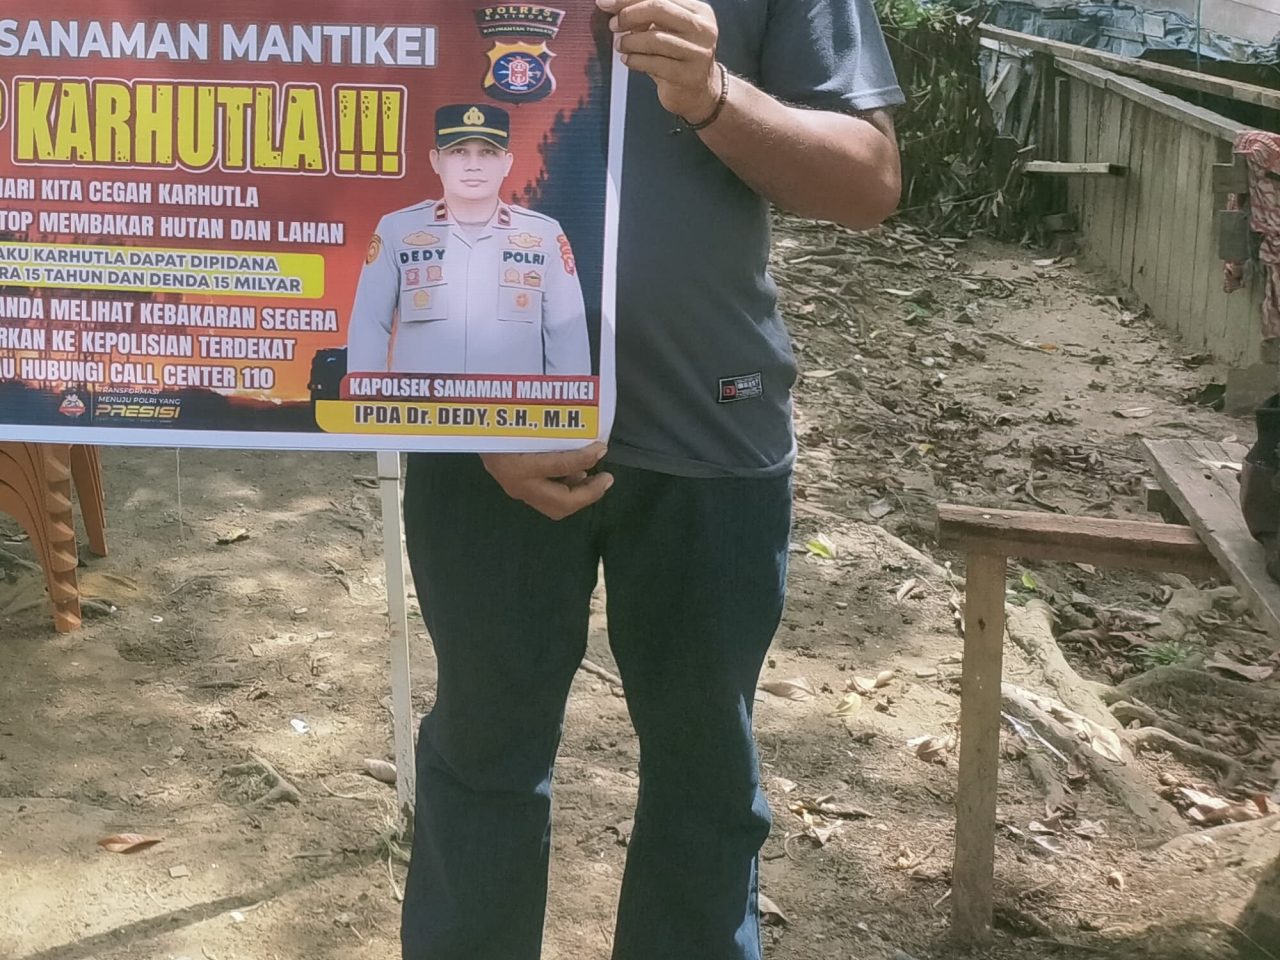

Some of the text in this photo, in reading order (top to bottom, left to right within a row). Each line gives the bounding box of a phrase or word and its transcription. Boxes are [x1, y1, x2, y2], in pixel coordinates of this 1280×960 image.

[485, 6, 552, 16] POLRES
[222, 23, 439, 67] MANTIKEI
[16, 78, 325, 171] KARHUTLA
[336, 88, 404, 174] !!!
[42, 179, 83, 200] KITA
[89, 181, 152, 204] CEGAH
[158, 184, 260, 208] KARHUTLA
[39, 211, 154, 236] MEMBAKAR
[160, 217, 224, 240] HUTAN
[231, 219, 272, 242] DAN
[278, 221, 344, 244] LAHAN
[33, 247, 124, 265] KARHUTLA
[129, 251, 187, 268] DAPAT
[190, 254, 278, 271] DIPIDANA
[399, 249, 446, 264] DEDY
[503, 251, 545, 265] POLRI
[24, 267, 40, 281] 15
[43, 268, 105, 283] TAHUN
[108, 270, 146, 286] DAN
[149, 272, 210, 289] DENDA
[213, 275, 230, 290] 15
[234, 276, 301, 292] MILYAR
[51, 298, 133, 323] MELIHAT
[140, 303, 256, 329] KEBAKARAN
[262, 308, 339, 331] SEGERA
[52, 329, 74, 351] KE
[80, 330, 193, 357] KEPOLISIAN
[199, 336, 296, 360] TERDEKAT
[21, 358, 104, 382] HUBUNGI
[110, 361, 157, 385] CALL
[163, 365, 237, 388] CENTER
[243, 367, 274, 389] 110
[349, 377, 595, 400] KAPOLSEK SANAMAN MANTIKEI
[354, 405, 585, 430] IPDA Dr. DEDY, S.H., M.H.
